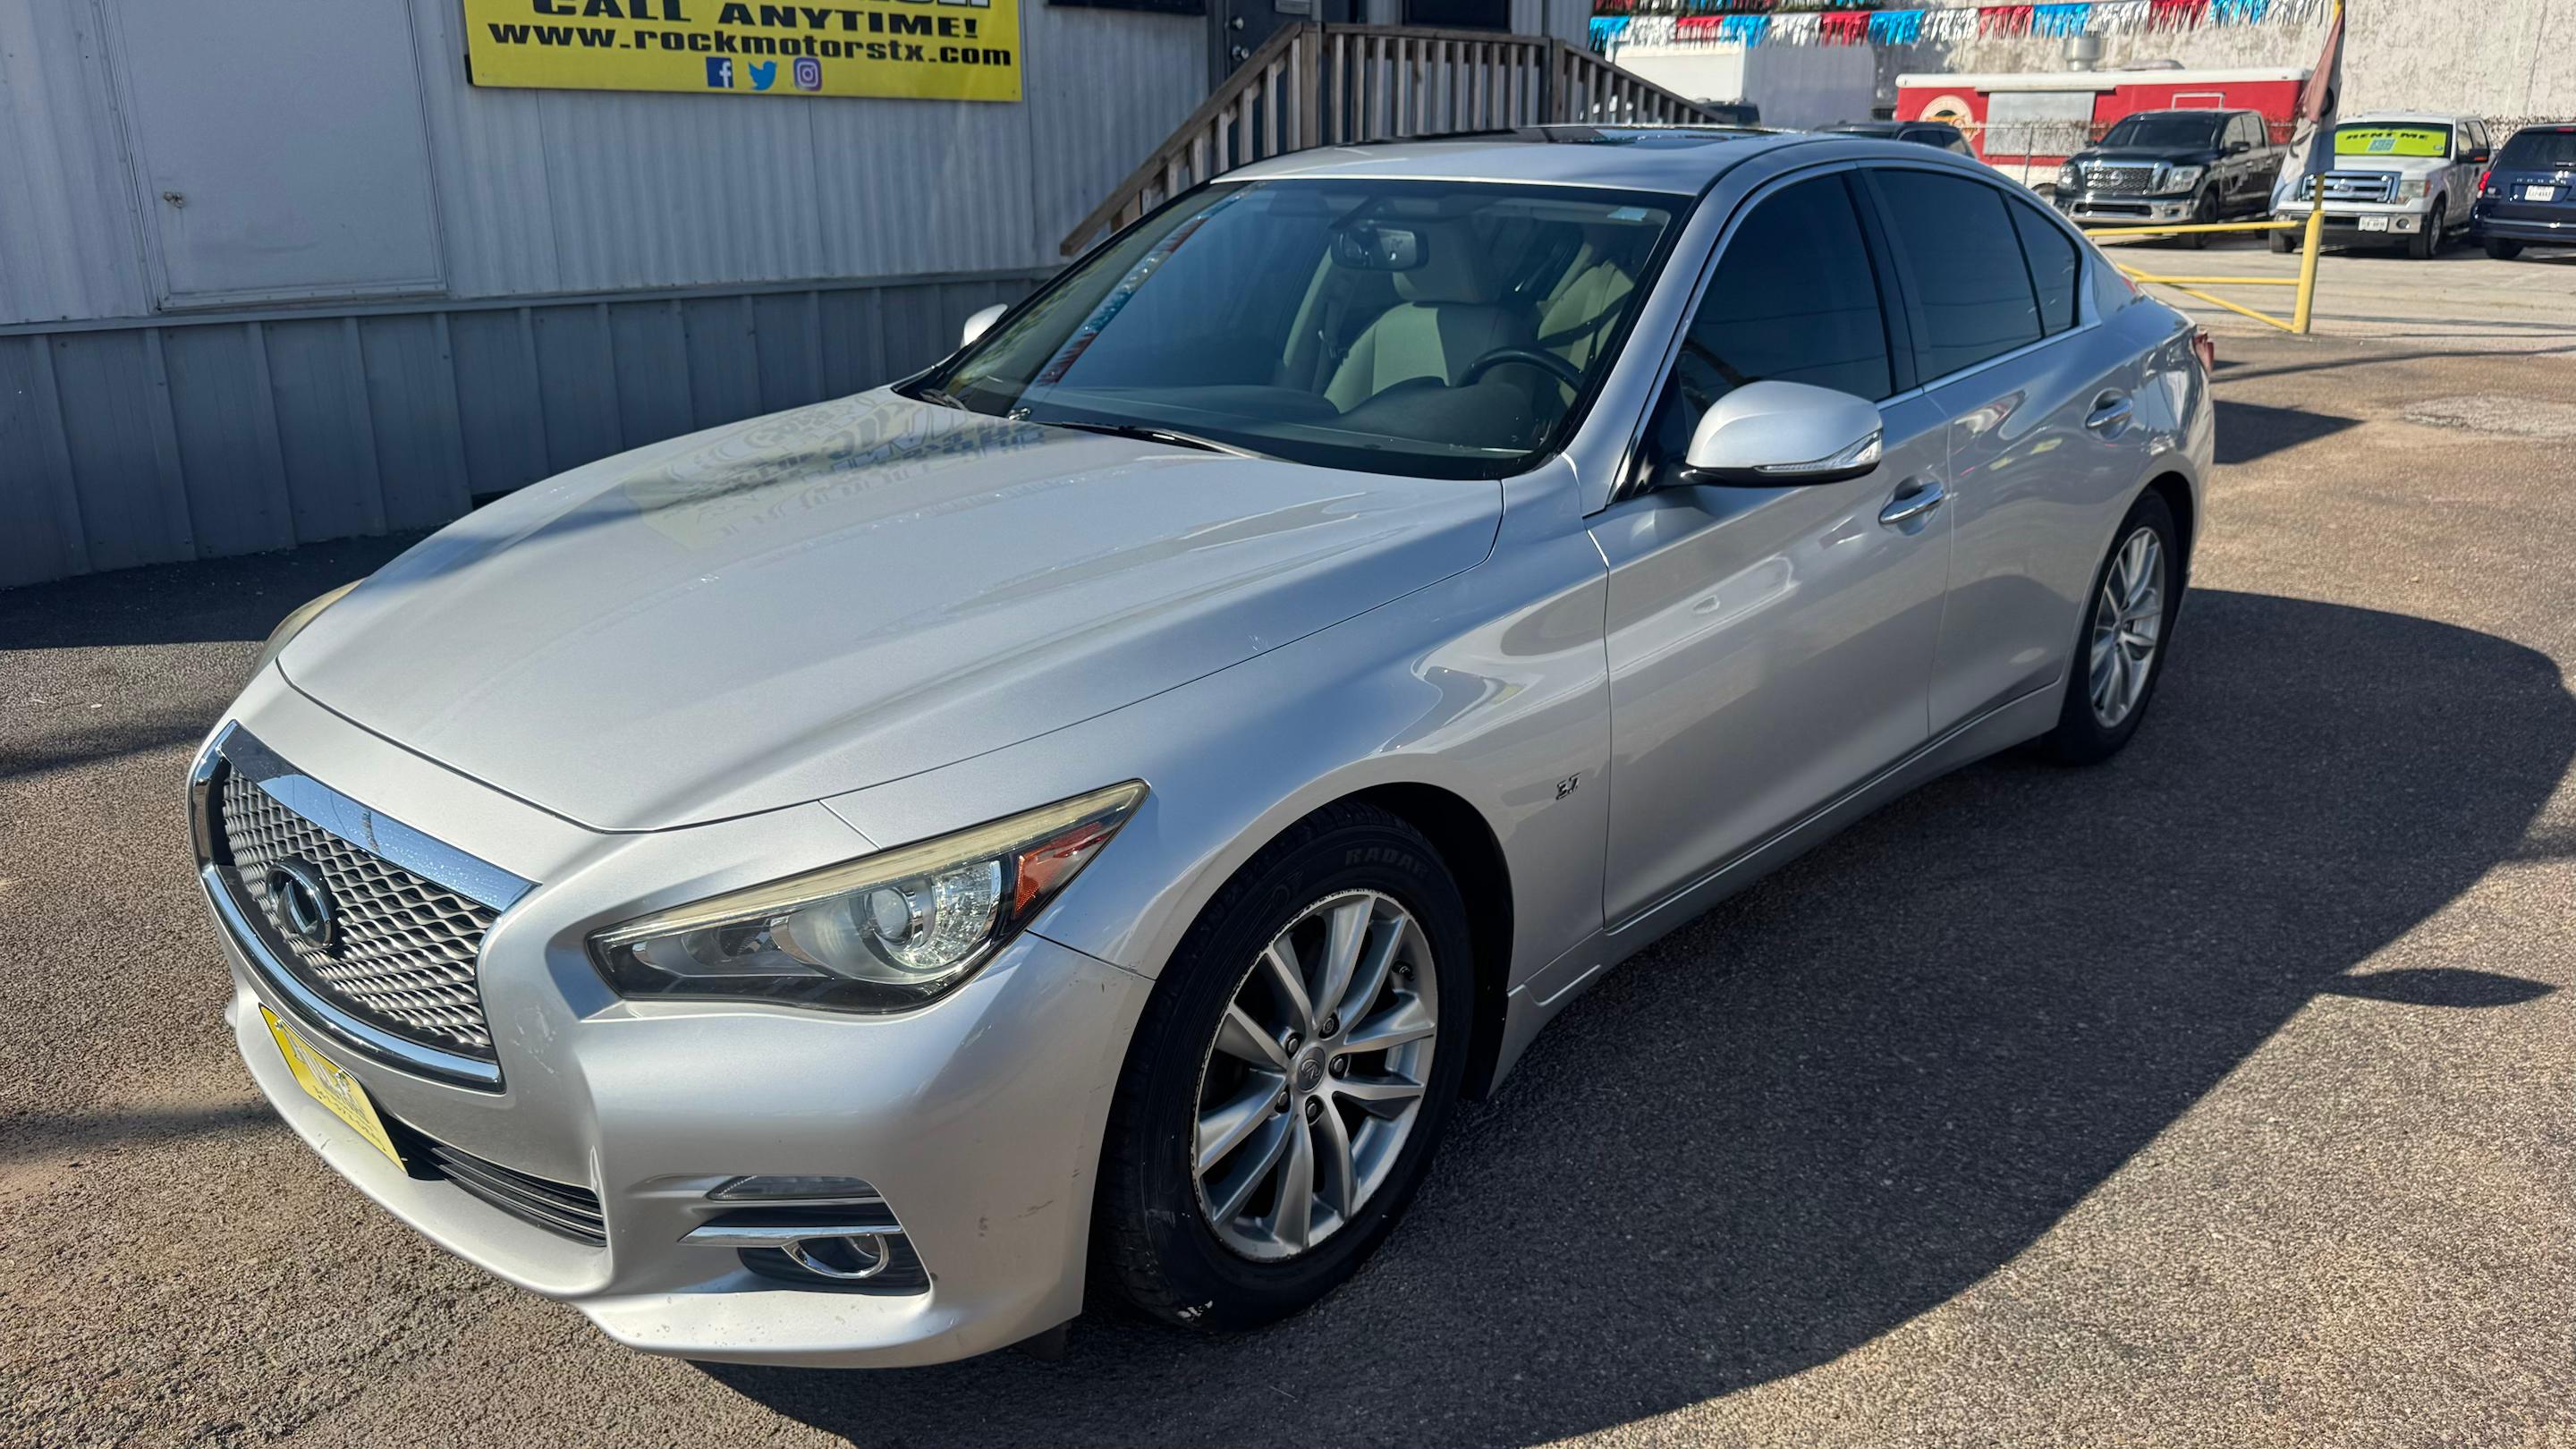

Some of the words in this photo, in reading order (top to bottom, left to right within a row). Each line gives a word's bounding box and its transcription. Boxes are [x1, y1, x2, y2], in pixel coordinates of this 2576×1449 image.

[532, 0, 692, 22] CALL
[717, 3, 979, 39] ANYTIME!
[487, 23, 1012, 66] www.rockmotorstx.com
[1344, 847, 1429, 878] RADAR
